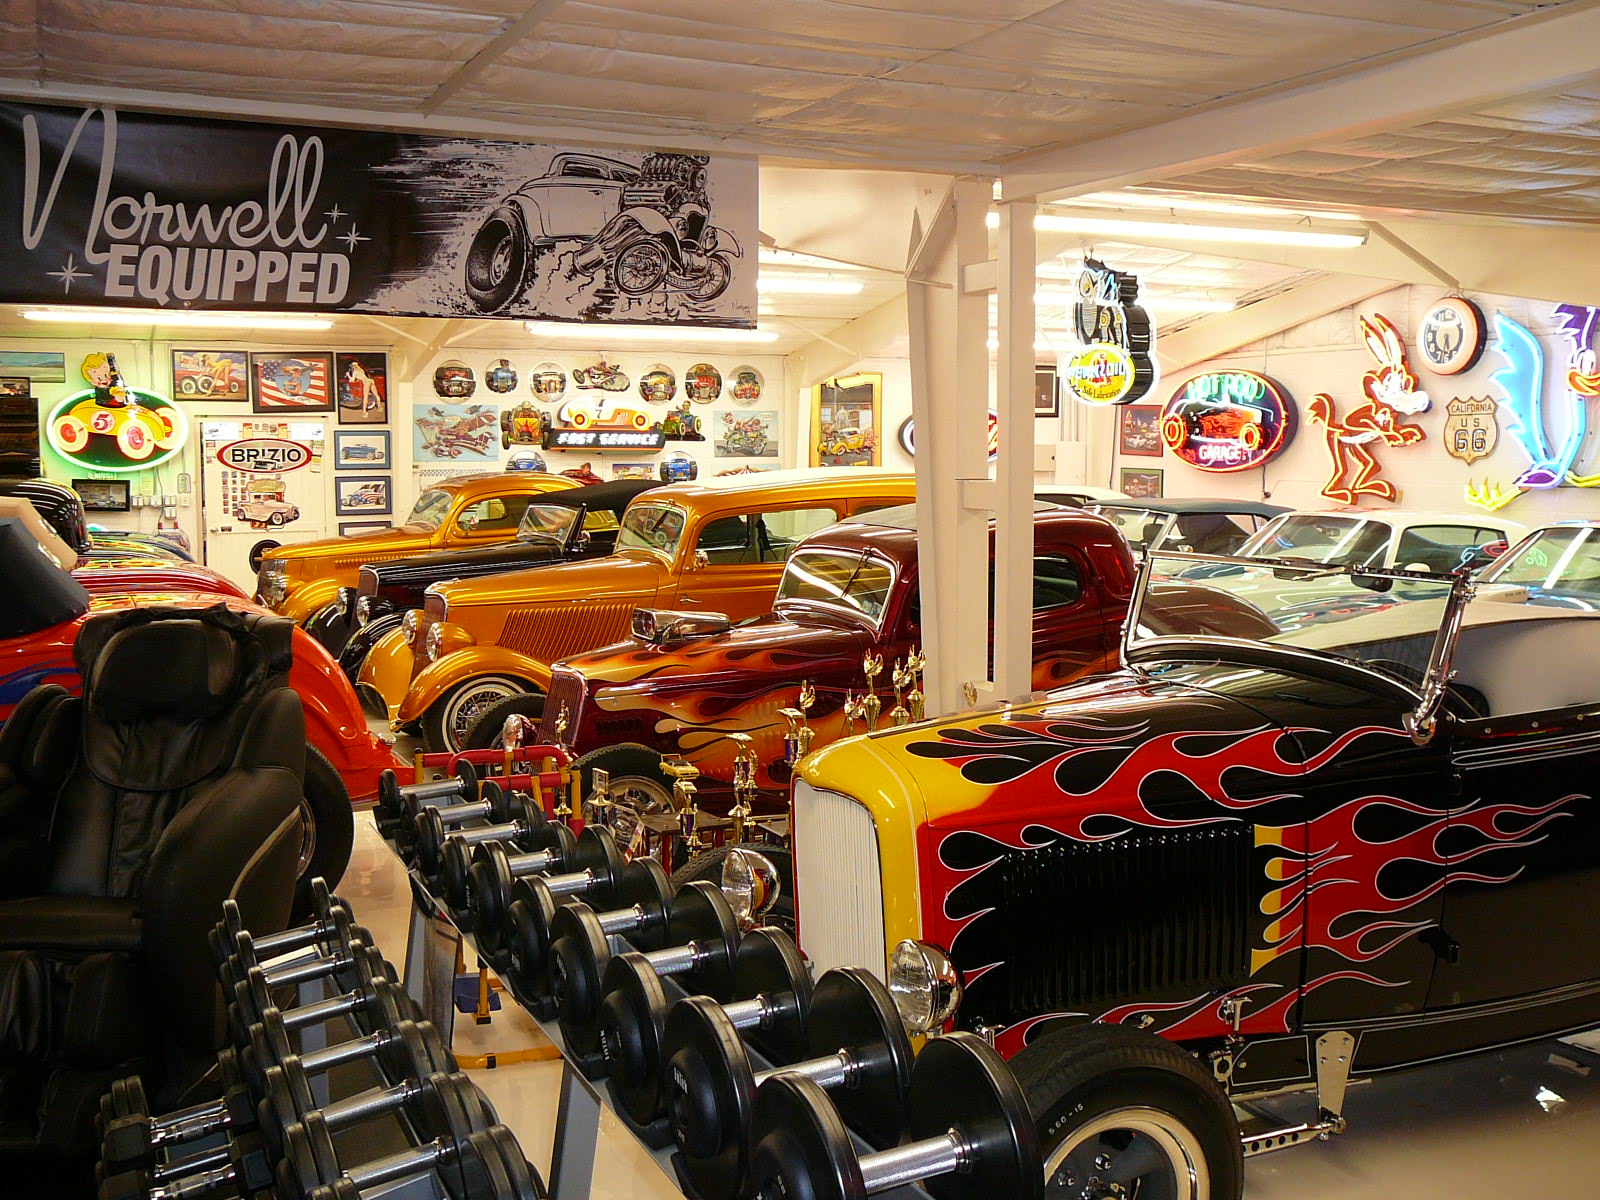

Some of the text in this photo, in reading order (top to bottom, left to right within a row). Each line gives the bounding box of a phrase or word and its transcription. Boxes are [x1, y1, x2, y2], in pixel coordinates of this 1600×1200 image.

[22, 107, 328, 265] Norwell
[104, 243, 350, 306] EQUIPPED
[1187, 374, 1264, 402] HOT ROD
[1451, 403, 1492, 413] CALIFORNIA
[1455, 429, 1486, 452] 66
[231, 448, 302, 463] BRIZIO
[1199, 444, 1241, 461] GARAGE
